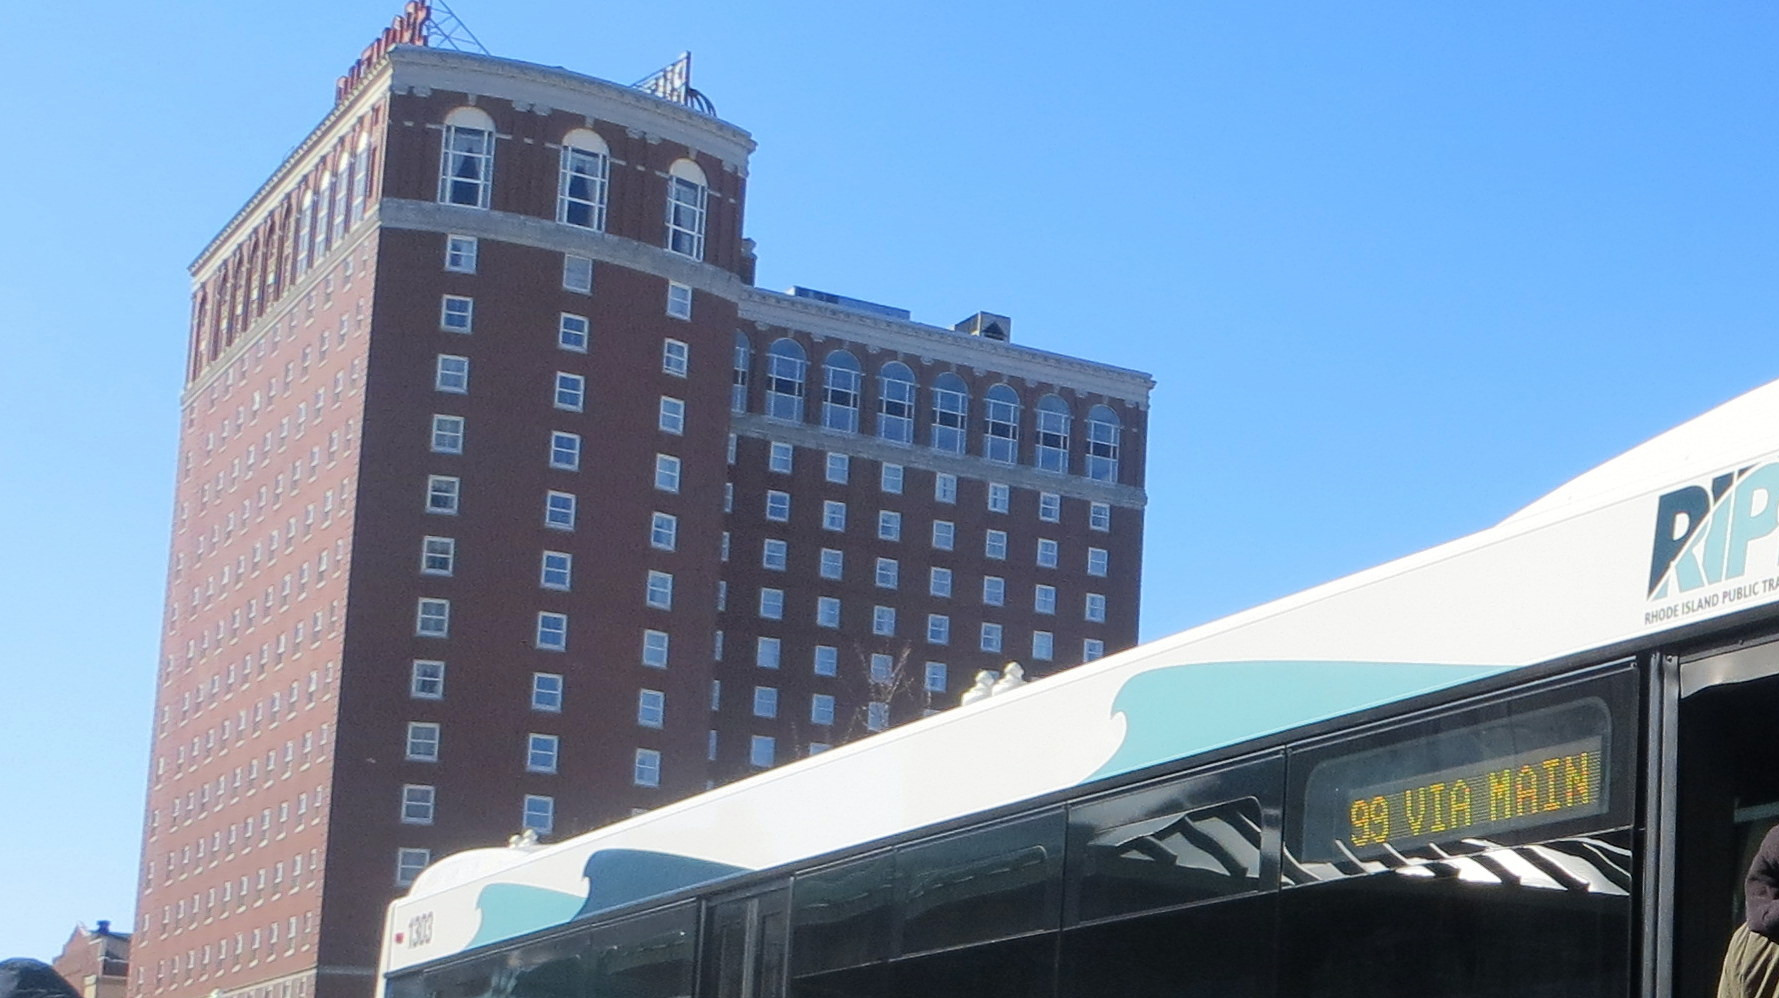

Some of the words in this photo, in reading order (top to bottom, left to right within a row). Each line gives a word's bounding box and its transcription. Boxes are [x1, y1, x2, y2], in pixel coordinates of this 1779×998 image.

[1643, 603, 1680, 626] RHODE
[1681, 593, 1720, 616] ISLAND
[1721, 581, 1760, 605] PUBLIC
[1350, 795, 1390, 848] 99
[1404, 778, 1472, 836] VIA
[1487, 751, 1590, 822] MAIN
[408, 910, 434, 950] 1303
